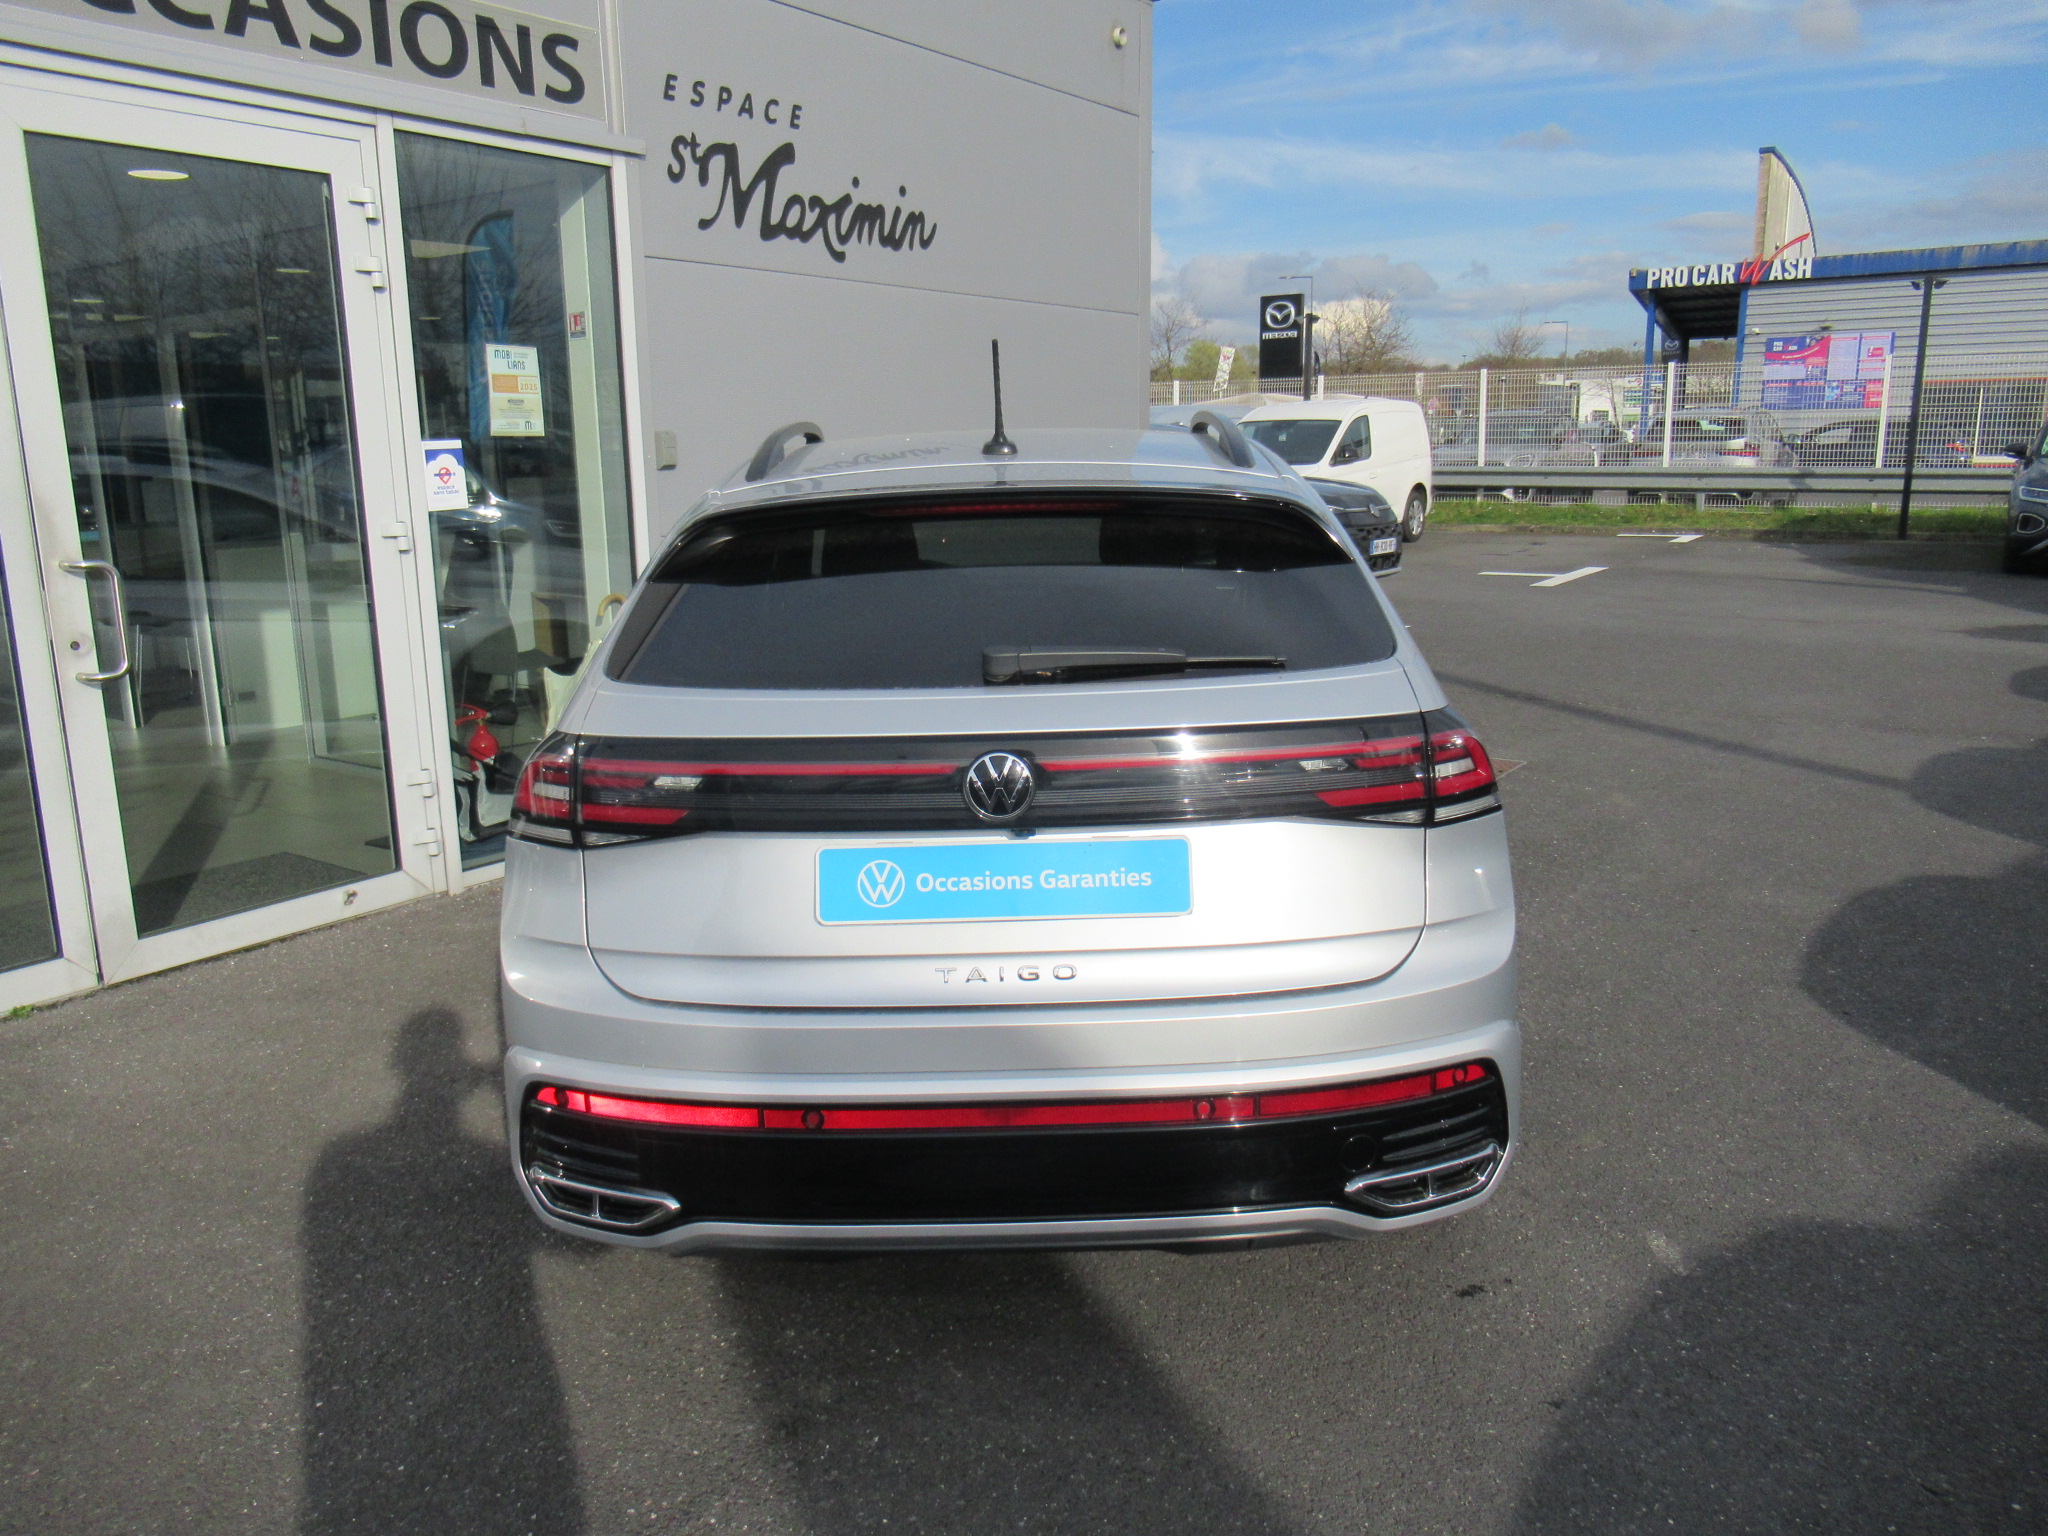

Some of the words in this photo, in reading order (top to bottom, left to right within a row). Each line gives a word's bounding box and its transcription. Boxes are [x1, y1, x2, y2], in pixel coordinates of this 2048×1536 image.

[76, 0, 586, 104] ASIONS
[663, 73, 802, 129] ESPACE
[698, 142, 937, 263] Maximin
[1646, 266, 1688, 289] PRO
[1692, 263, 1735, 286] CAR
[1739, 232, 1812, 285] WASH
[520, 382, 538, 391] 2025
[916, 870, 1033, 892] Occasions
[1039, 867, 1152, 889] Garanties
[935, 964, 1078, 984] TAIGO
